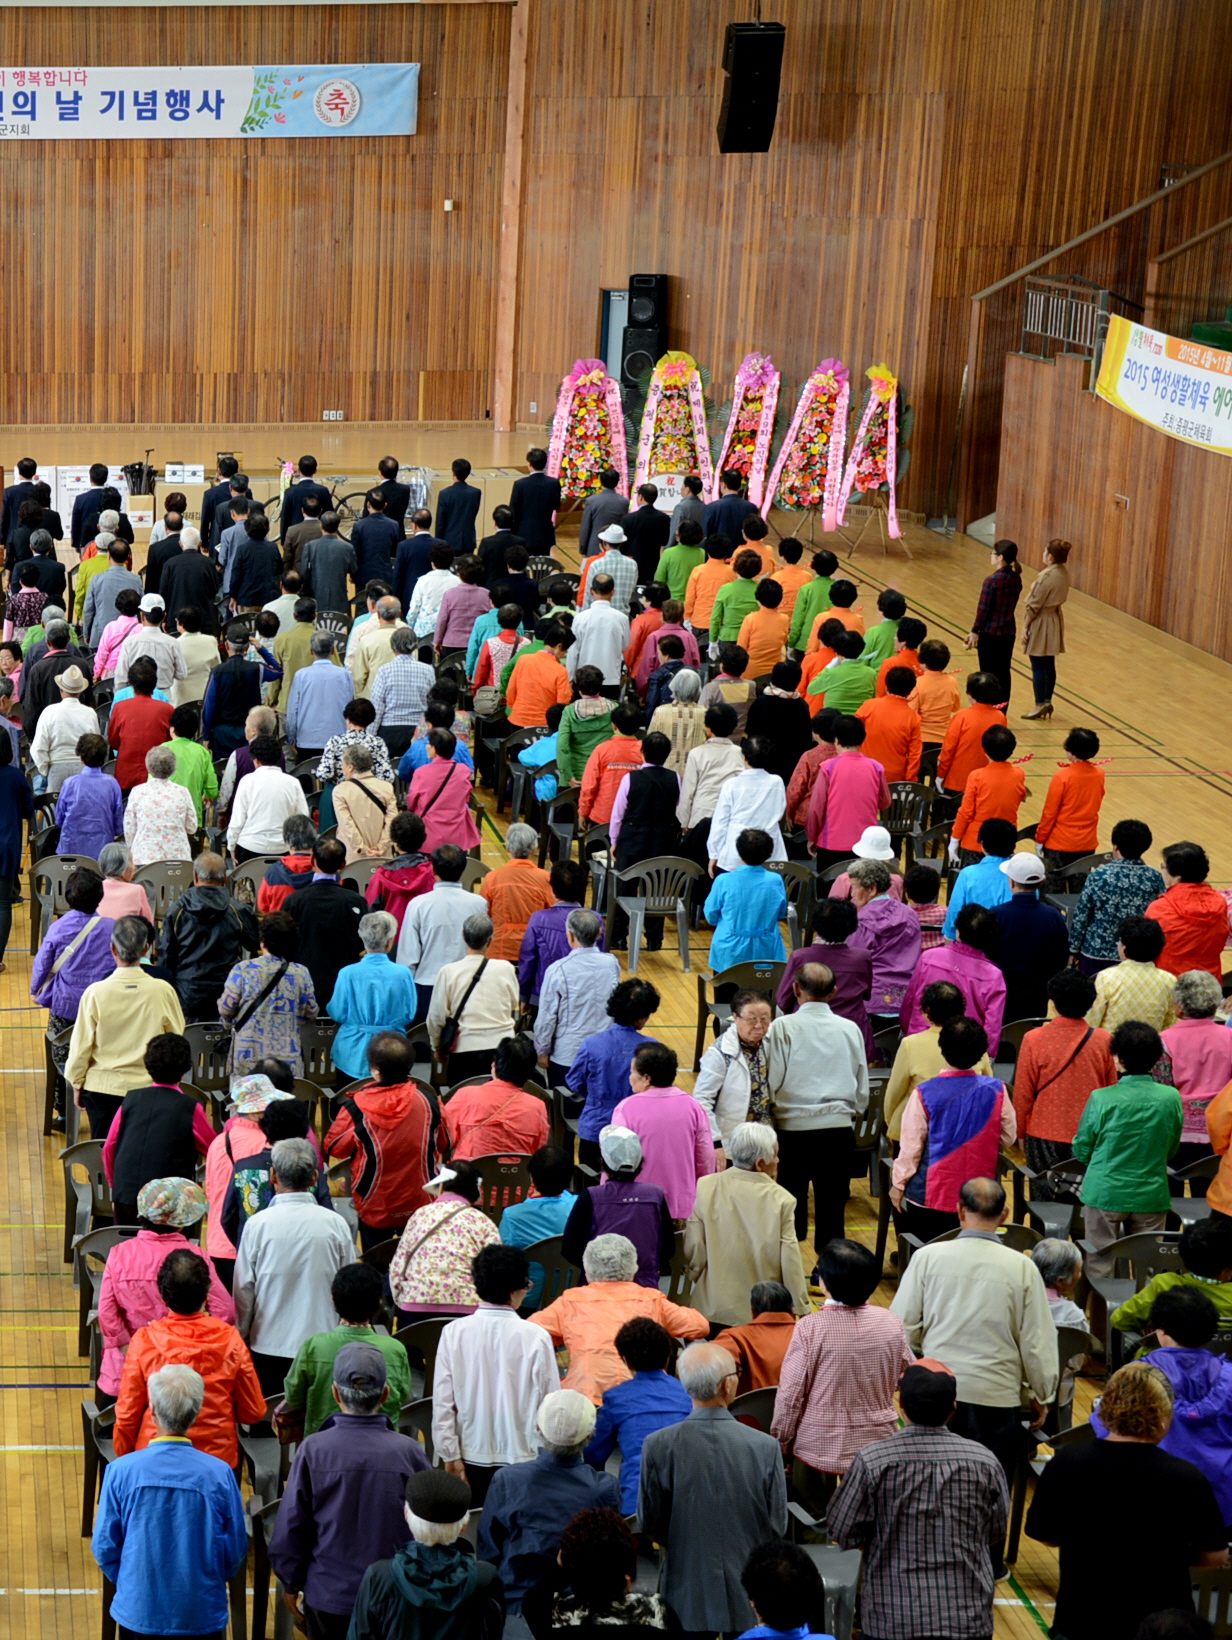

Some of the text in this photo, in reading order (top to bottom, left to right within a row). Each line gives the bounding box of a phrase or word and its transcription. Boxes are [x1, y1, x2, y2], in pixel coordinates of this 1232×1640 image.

[12, 70, 88, 87] 행복합니다
[55, 90, 83, 122] 날
[99, 89, 225, 122] 기념행사
[325, 88, 350, 116] 축
[1124, 358, 1150, 391] 2015
[1151, 366, 1210, 412] 여성생활체육
